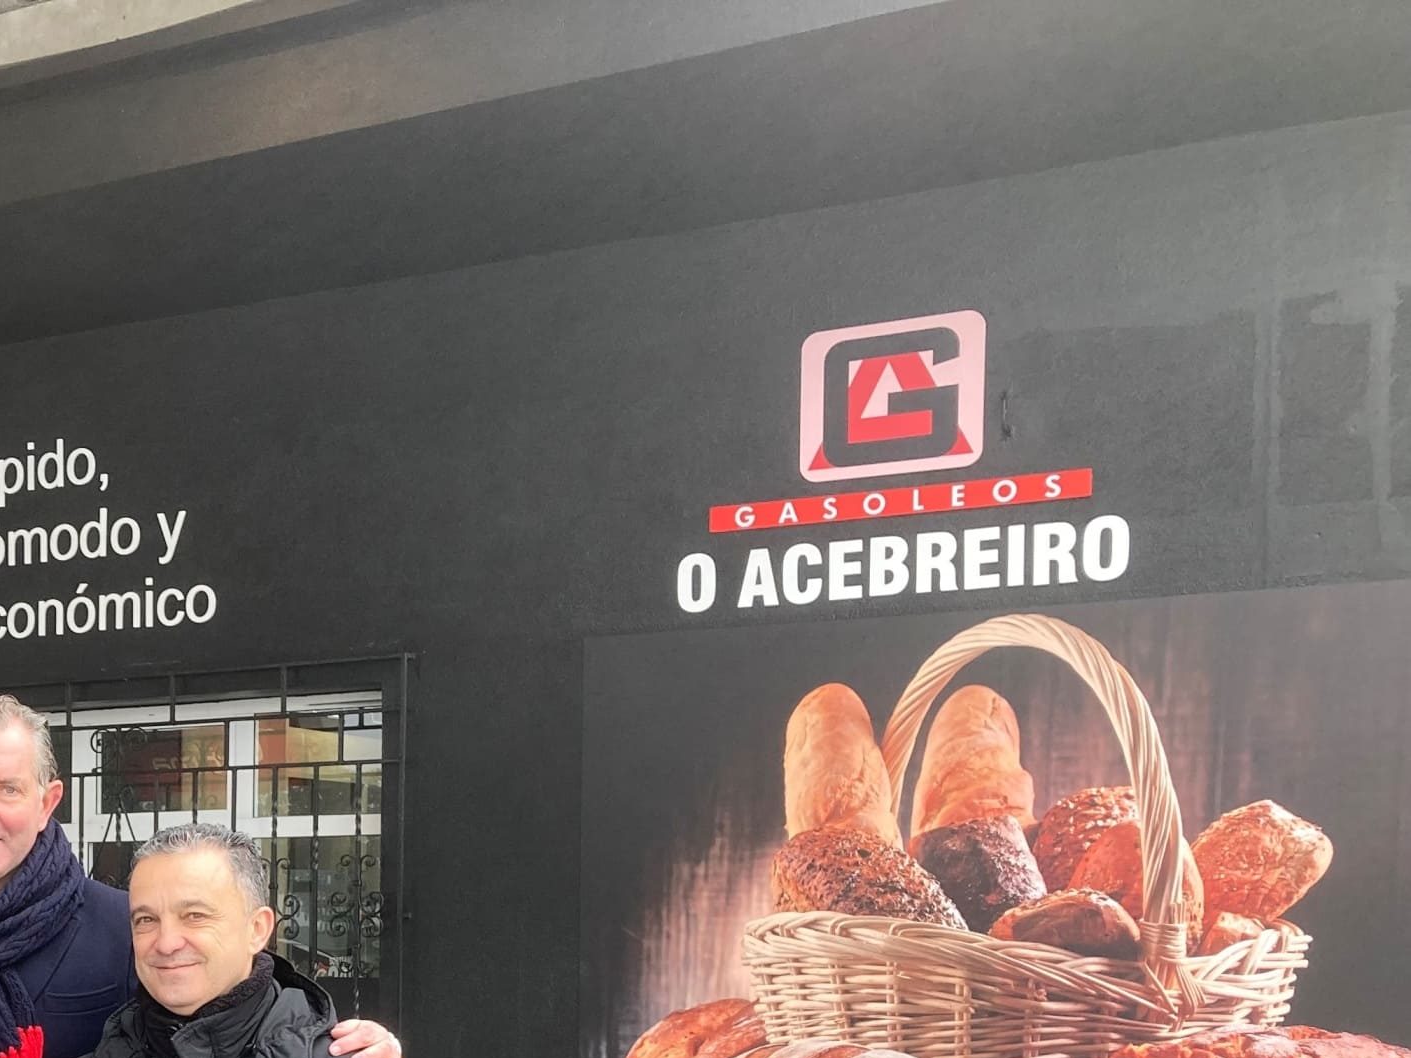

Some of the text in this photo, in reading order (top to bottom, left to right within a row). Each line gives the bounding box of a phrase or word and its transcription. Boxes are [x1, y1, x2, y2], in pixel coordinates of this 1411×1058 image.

[733, 473, 1063, 528] GASOLEOS
[156, 510, 187, 565] y
[676, 514, 1131, 614] O ACEBREIRO
